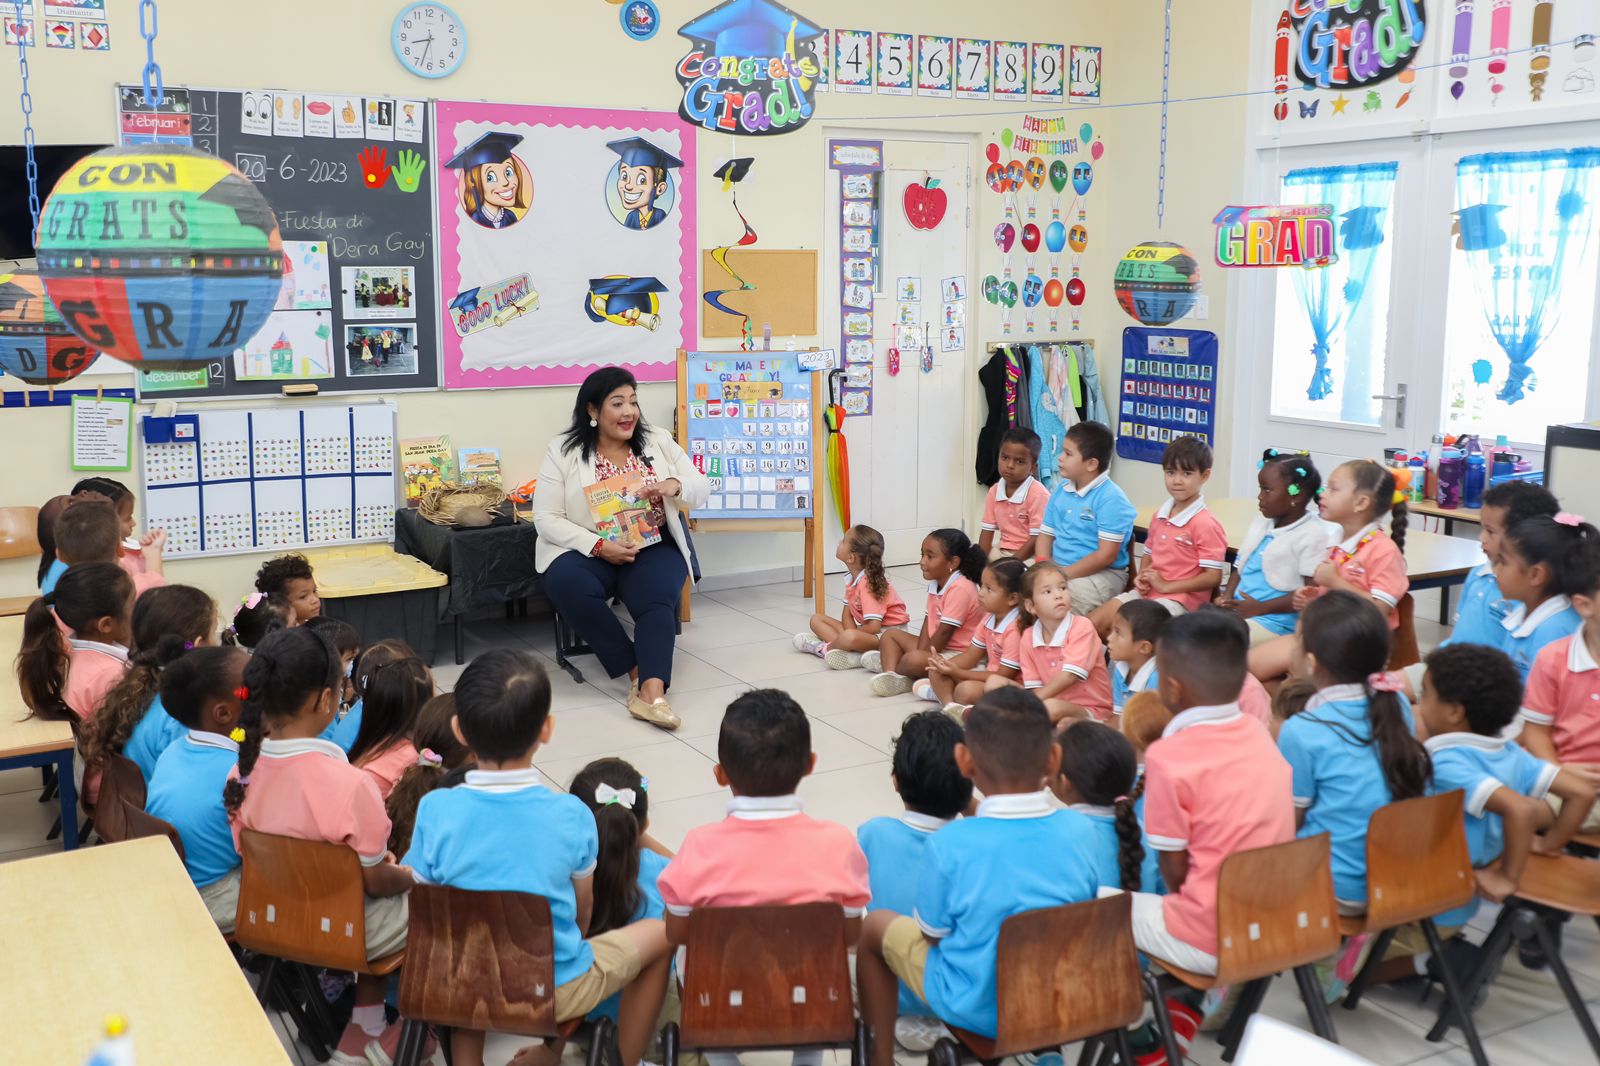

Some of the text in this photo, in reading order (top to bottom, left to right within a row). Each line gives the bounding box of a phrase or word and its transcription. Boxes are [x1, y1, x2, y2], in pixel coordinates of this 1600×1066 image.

[413, 11, 421, 20] 11
[425, 9, 434, 18] 12
[403, 20, 412, 29] 10
[448, 24, 455, 34] 2
[400, 33, 407, 41] 9
[451, 38, 458, 47] 3
[1298, 0, 1424, 88] Grad!
[404, 46, 411, 56] 8
[448, 51, 454, 60] 4
[413, 57, 420, 66] 7
[439, 59, 446, 69] 5
[846, 43, 863, 74] 4
[888, 46, 902, 76] 5
[928, 49, 943, 78] 6
[426, 62, 433, 71] 6
[678, 52, 819, 86] Congrats
[966, 52, 981, 81] 7
[1004, 53, 1017, 83] 8
[1041, 55, 1055, 84] 9
[1074, 58, 1098, 84] 10
[134, 94, 176, 107] jaari
[202, 97, 208, 111] 1
[685, 76, 811, 132] Grad!
[130, 113, 181, 128] februari
[198, 116, 213, 132] 2
[78, 162, 177, 187] CON
[47, 199, 188, 241] GRATS
[280, 210, 365, 230] Fiesta di
[1217, 218, 1334, 266] GRAD
[1126, 249, 1158, 259] CON
[459, 276, 530, 334] GOOD LUCK!
[59, 299, 250, 349] GRA
[803, 352, 831, 364] 2023
[208, 362, 225, 379] 12
[719, 372, 752, 383] GREAT
[745, 460, 755, 469] 15
[762, 460, 773, 469] 16
[779, 460, 789, 469] 17
[796, 458, 806, 466] 18
[709, 478, 721, 487] 20
